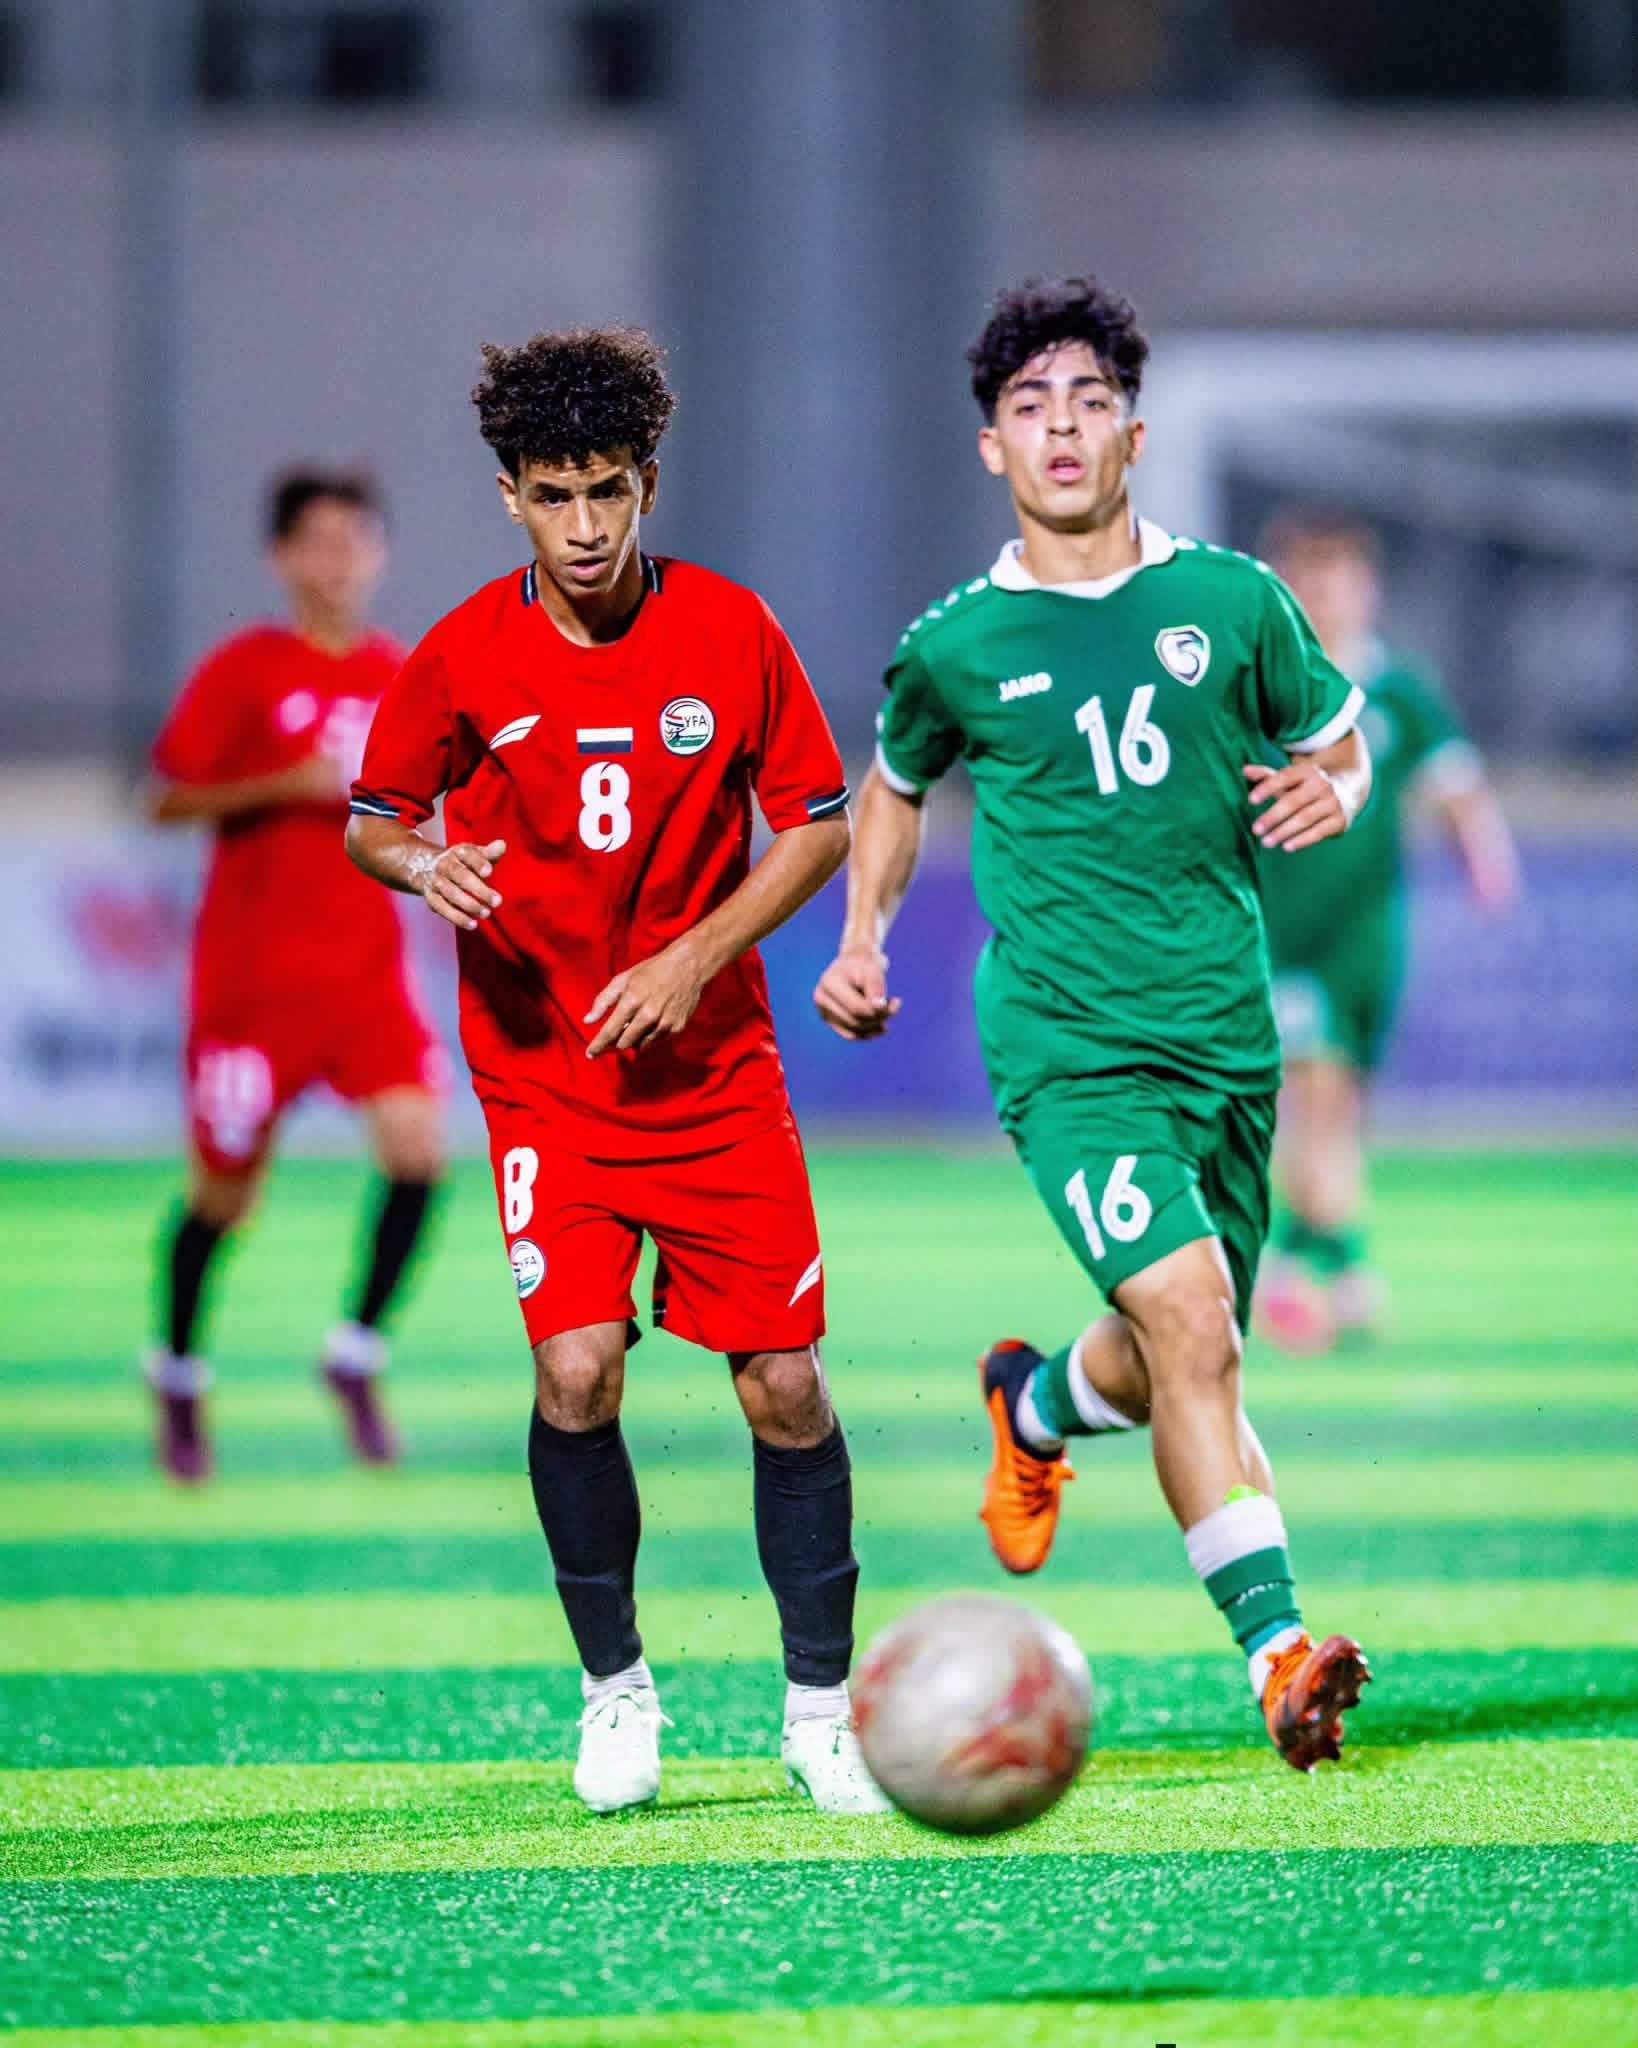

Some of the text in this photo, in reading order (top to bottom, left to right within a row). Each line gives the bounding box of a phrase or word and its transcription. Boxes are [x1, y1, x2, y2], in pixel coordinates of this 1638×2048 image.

[684, 715, 707, 727] YFA
[1075, 684, 1170, 795] 16
[578, 761, 632, 853] 8
[1065, 1155, 1152, 1260] 16
